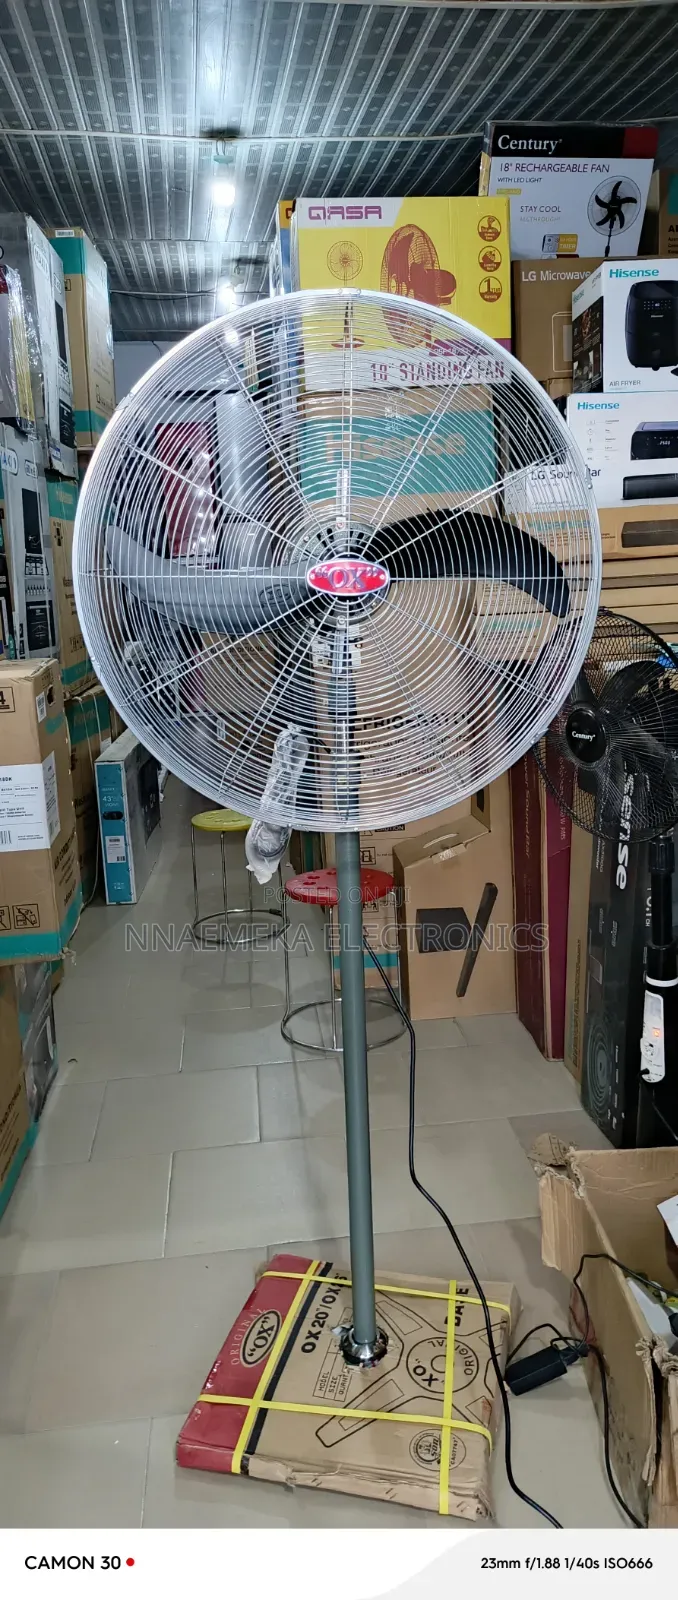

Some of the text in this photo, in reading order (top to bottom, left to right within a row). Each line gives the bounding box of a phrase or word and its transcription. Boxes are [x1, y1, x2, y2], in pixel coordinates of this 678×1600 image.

[515, 163, 589, 173] RECHARGEABLE
[590, 164, 610, 173] FAN
[308, 205, 382, 220] QASA
[522, 271, 536, 282] LG
[609, 268, 660, 279] Hisense
[399, 361, 472, 381] STANDING
[477, 360, 505, 380] FAN
[577, 401, 620, 410] Hisense
[325, 432, 466, 464] Hisense
[231, 1307, 266, 1366] ORIGINAL
[319, 1371, 330, 1391] MODEL
[328, 1376, 338, 1393] SIZE
